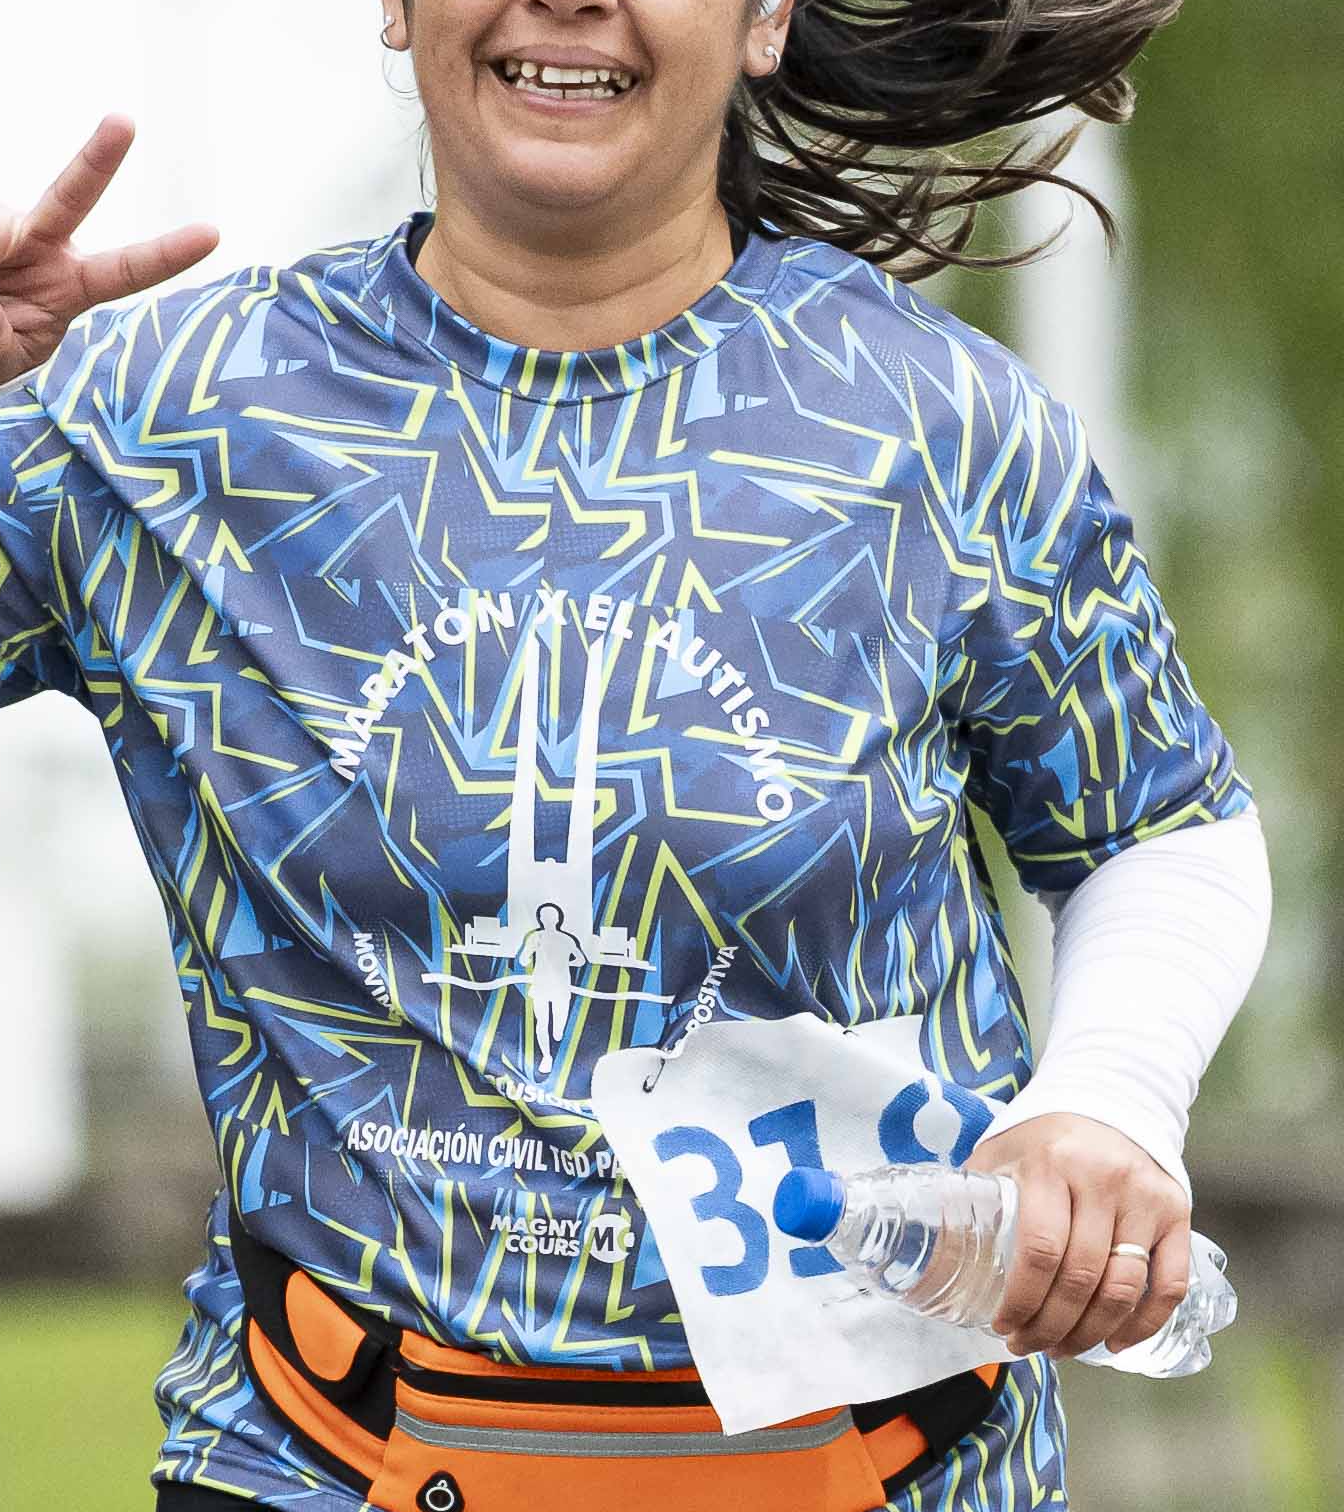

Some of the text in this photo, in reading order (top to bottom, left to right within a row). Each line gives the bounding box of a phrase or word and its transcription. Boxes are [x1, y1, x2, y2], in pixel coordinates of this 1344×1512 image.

[329, 588, 794, 822] MARATÓN X EL AUTISMO
[347, 1119, 484, 1166] ASOCIACIÓN
[488, 1137, 549, 1171] CIVIL
[549, 1144, 591, 1178] TGD
[489, 1214, 582, 1237] MAGNY
[505, 1234, 581, 1257] COURS
